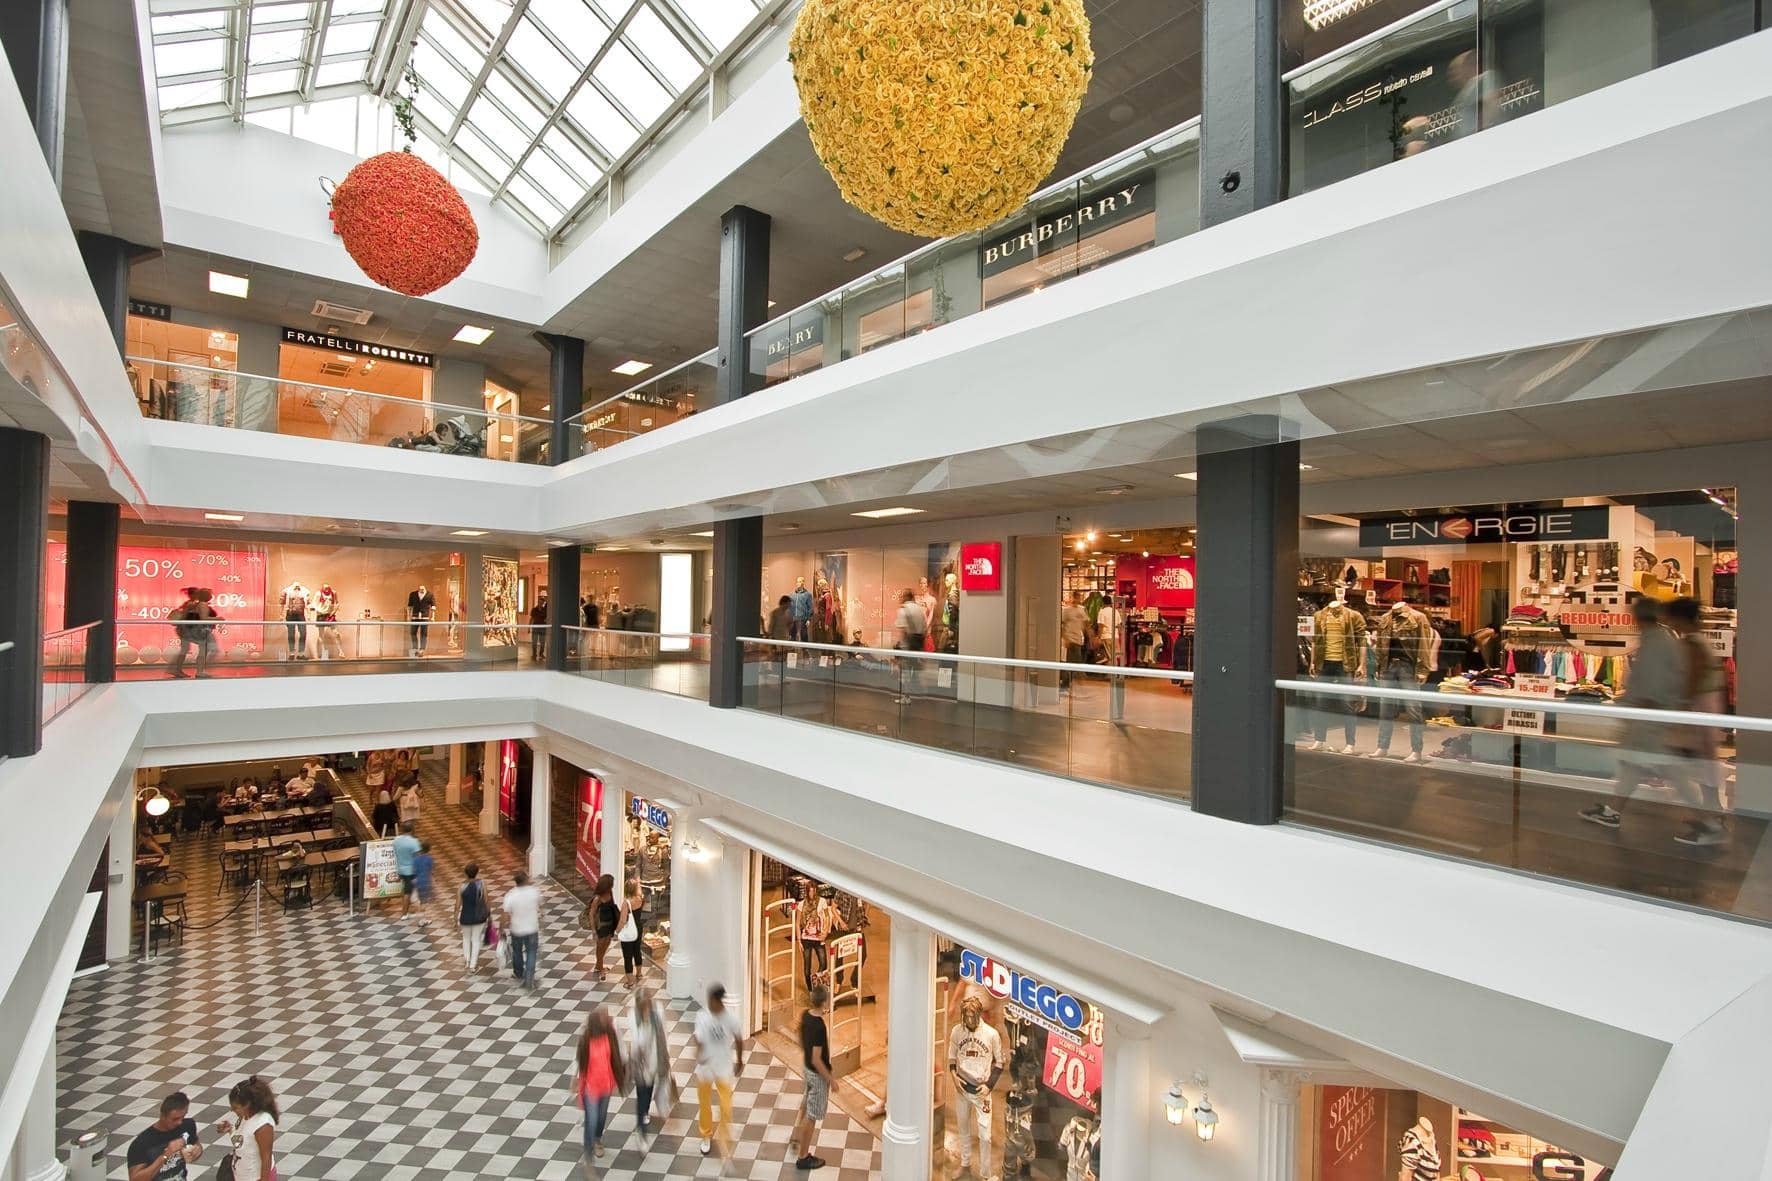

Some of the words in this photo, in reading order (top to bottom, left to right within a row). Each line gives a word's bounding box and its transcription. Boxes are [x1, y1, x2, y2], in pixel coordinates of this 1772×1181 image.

[985, 184, 1140, 265] BURBERRY
[1152, 575, 1180, 583] NORTH
[1164, 568, 1180, 576] THE
[1335, 1096, 1375, 1152] OFFER
